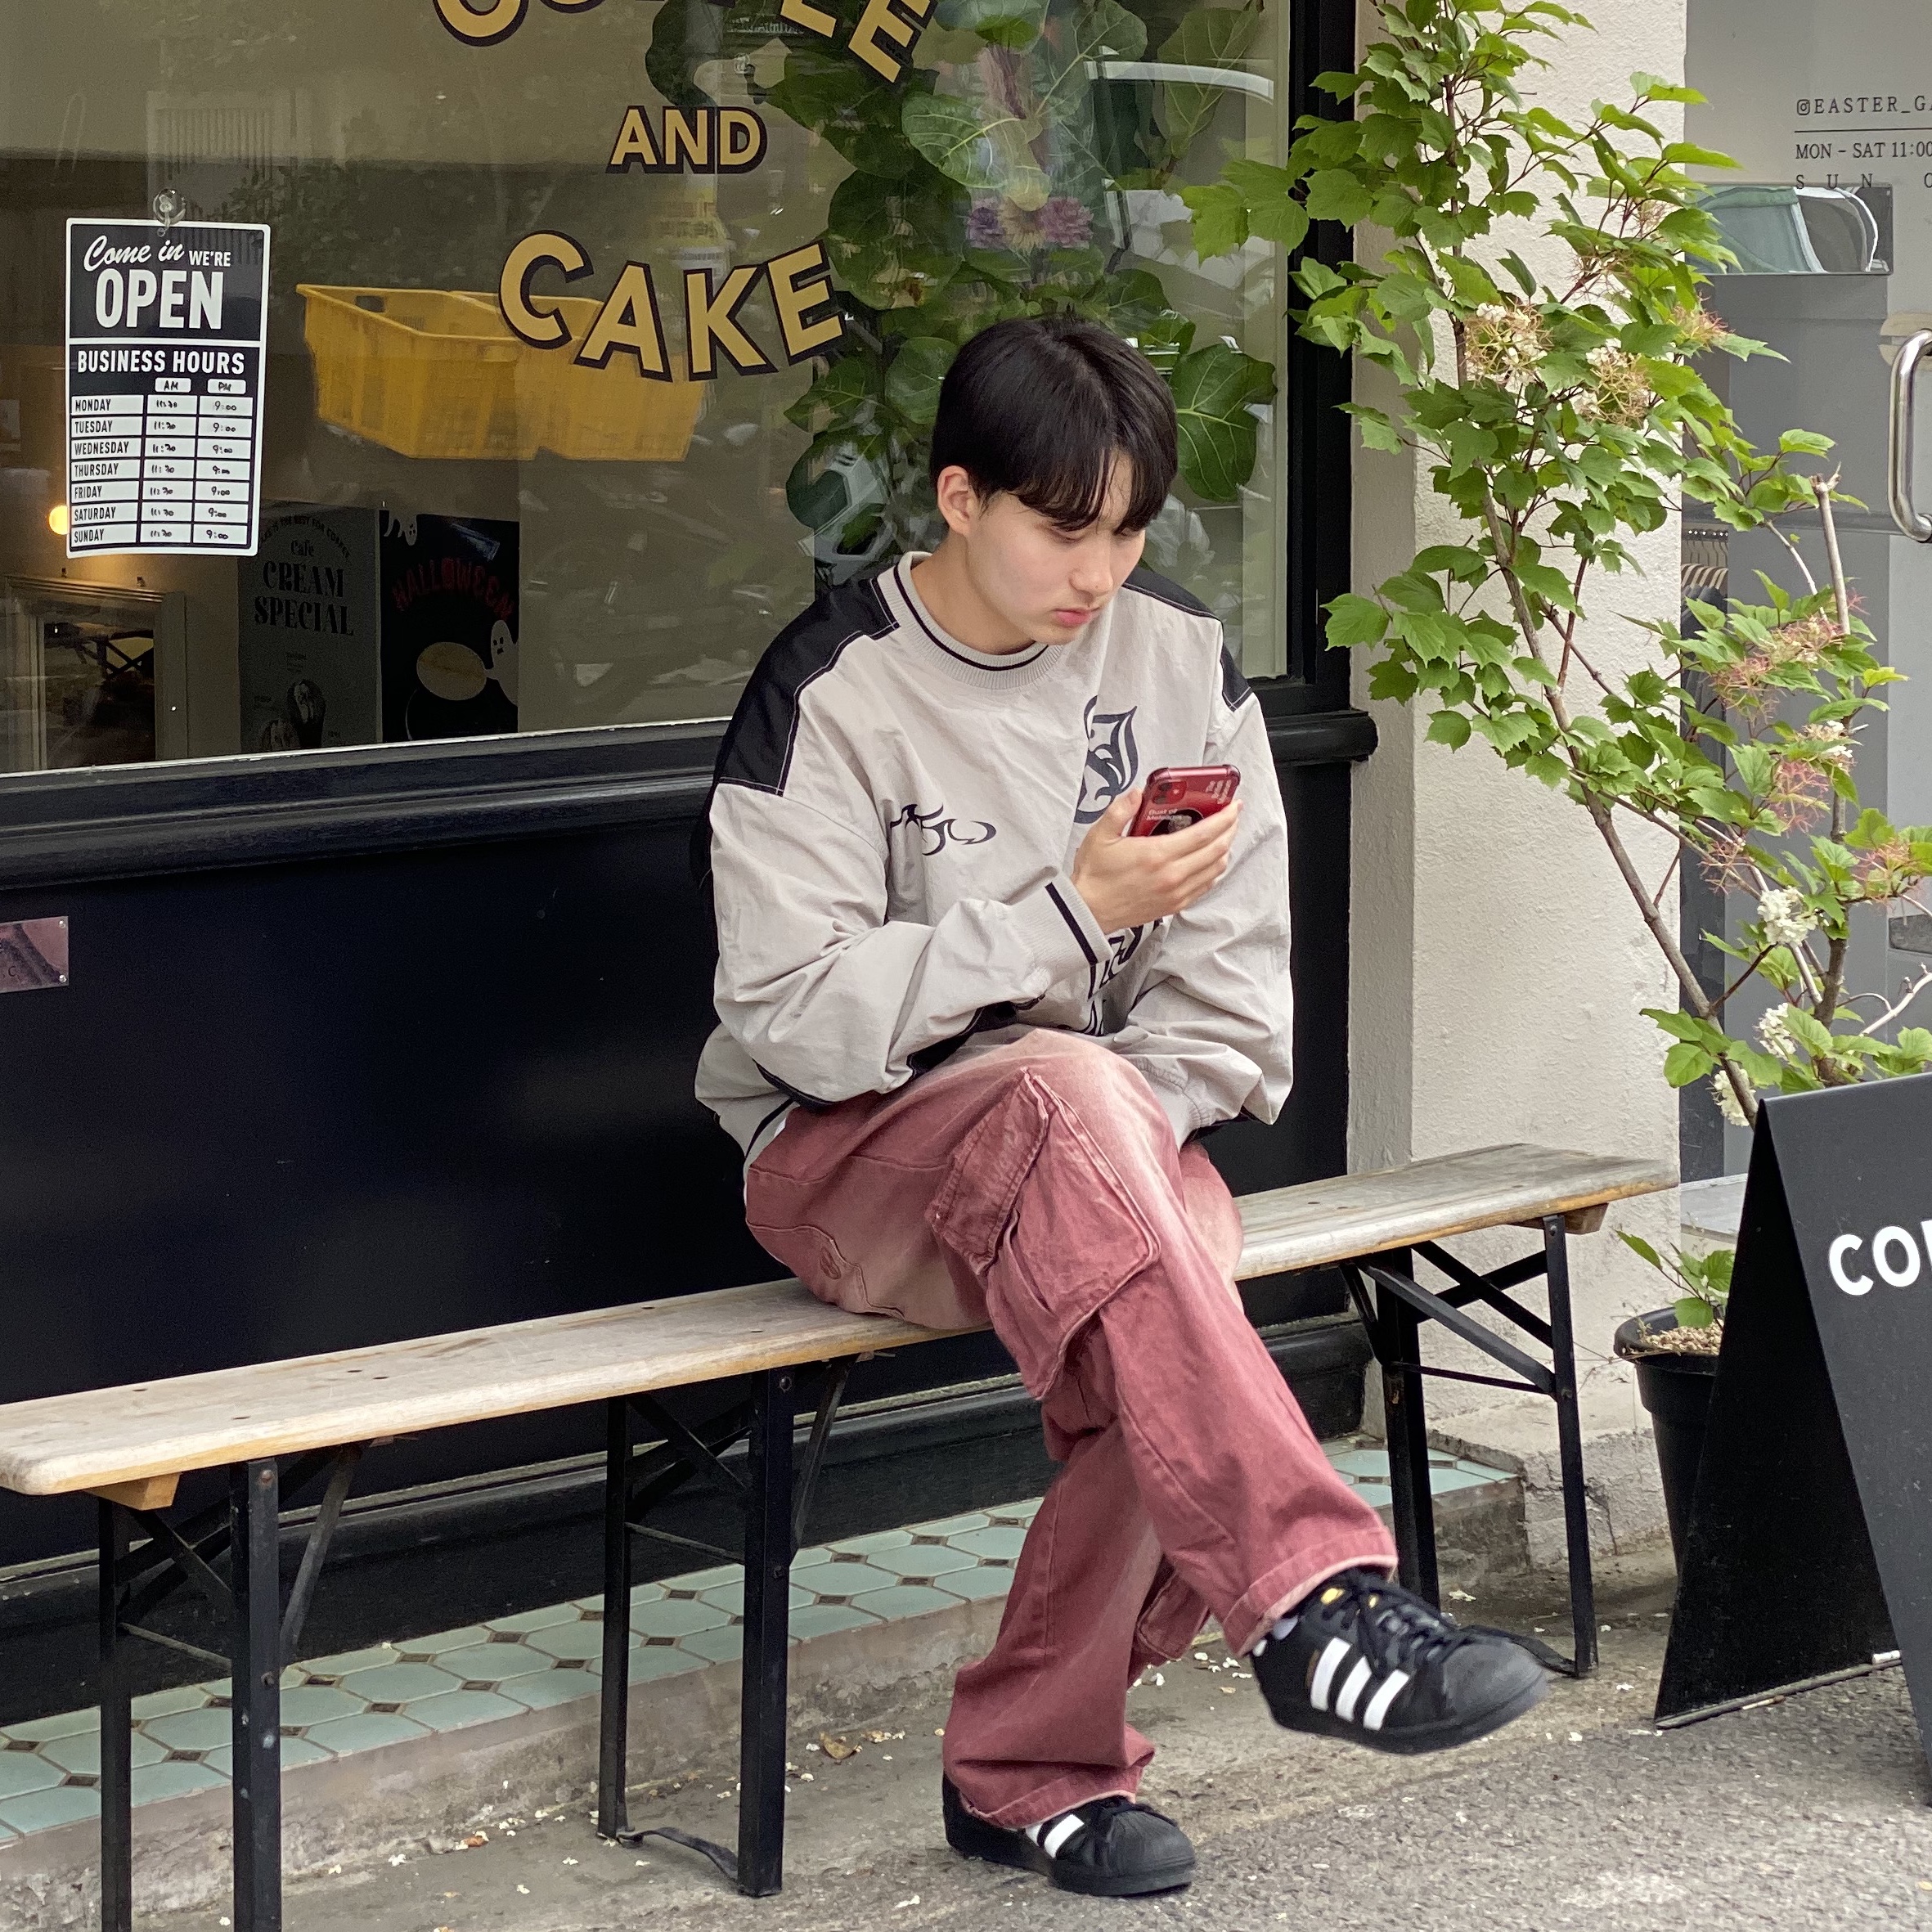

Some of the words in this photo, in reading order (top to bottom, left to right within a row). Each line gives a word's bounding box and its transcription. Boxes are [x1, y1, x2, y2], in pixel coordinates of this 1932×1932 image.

[1814, 96, 1932, 114] EASTER_G
[606, 106, 767, 173] AND
[1795, 144, 1831, 159] MON
[1853, 142, 1885, 158] SAT
[83, 236, 151, 272] Come
[158, 240, 185, 262] in
[189, 250, 231, 267] WE'RE
[96, 268, 223, 330] OPEN
[499, 230, 846, 381] CAKE
[78, 350, 165, 373] BUSINESS
[173, 352, 245, 374] HOURS
[164, 382, 178, 390] AM
[75, 399, 111, 411] MONDAY
[75, 420, 113, 433] TUESDAY
[74, 442, 129, 454] WEDNESDAY
[74, 463, 119, 477] THURSDAY
[74, 486, 102, 499] FRIDAY
[74, 507, 116, 521] SATURDAY
[74, 529, 104, 543] SUNDAY
[263, 560, 344, 598] CREAM
[254, 595, 354, 636] SPECIAL
